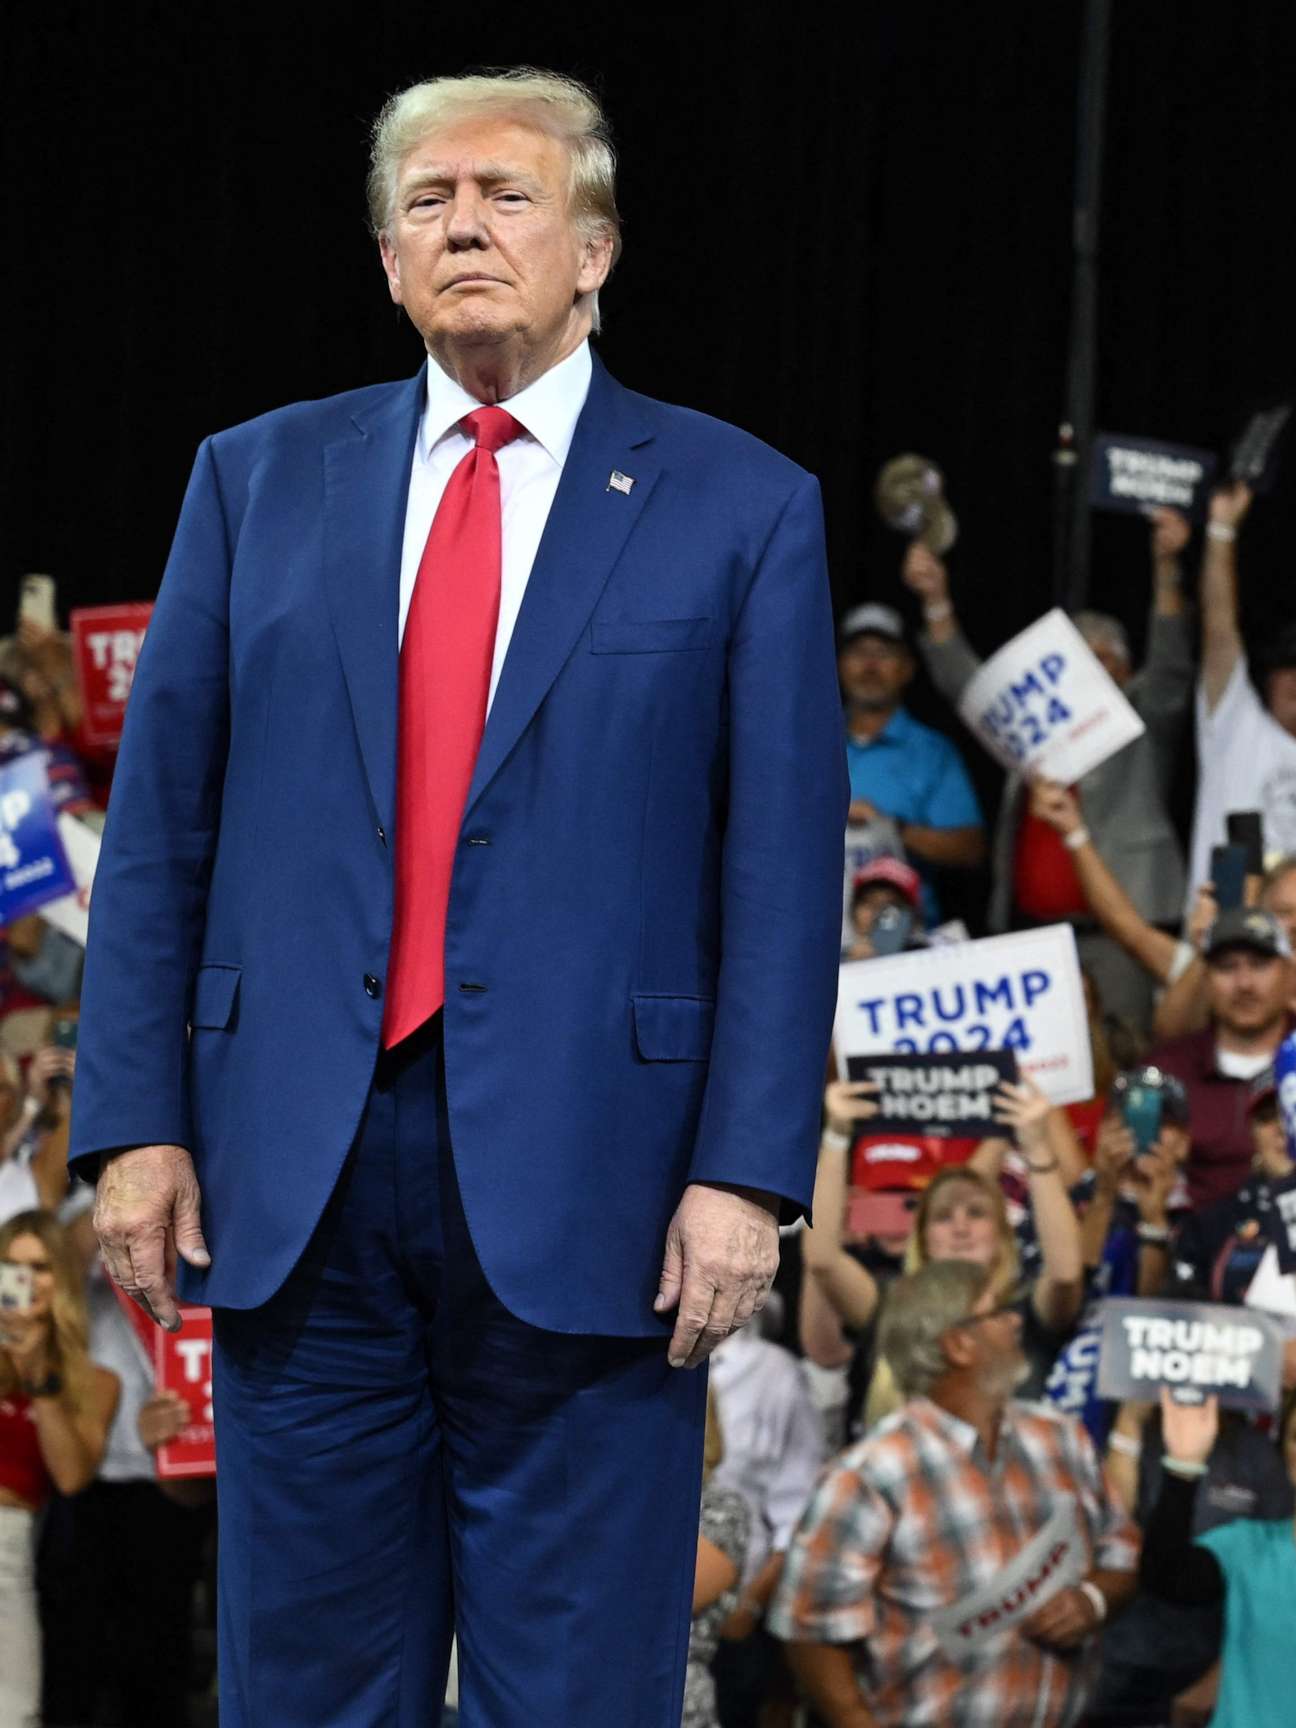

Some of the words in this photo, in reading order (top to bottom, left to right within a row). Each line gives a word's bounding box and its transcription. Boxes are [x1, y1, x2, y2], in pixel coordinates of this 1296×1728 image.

[858, 969, 1050, 1035] TRUMP
[868, 1064, 1000, 1094] TRUMP
[881, 1093, 992, 1121] NOEM
[1122, 1315, 1264, 1353] TRUMP
[1130, 1350, 1252, 1389] NOEM
